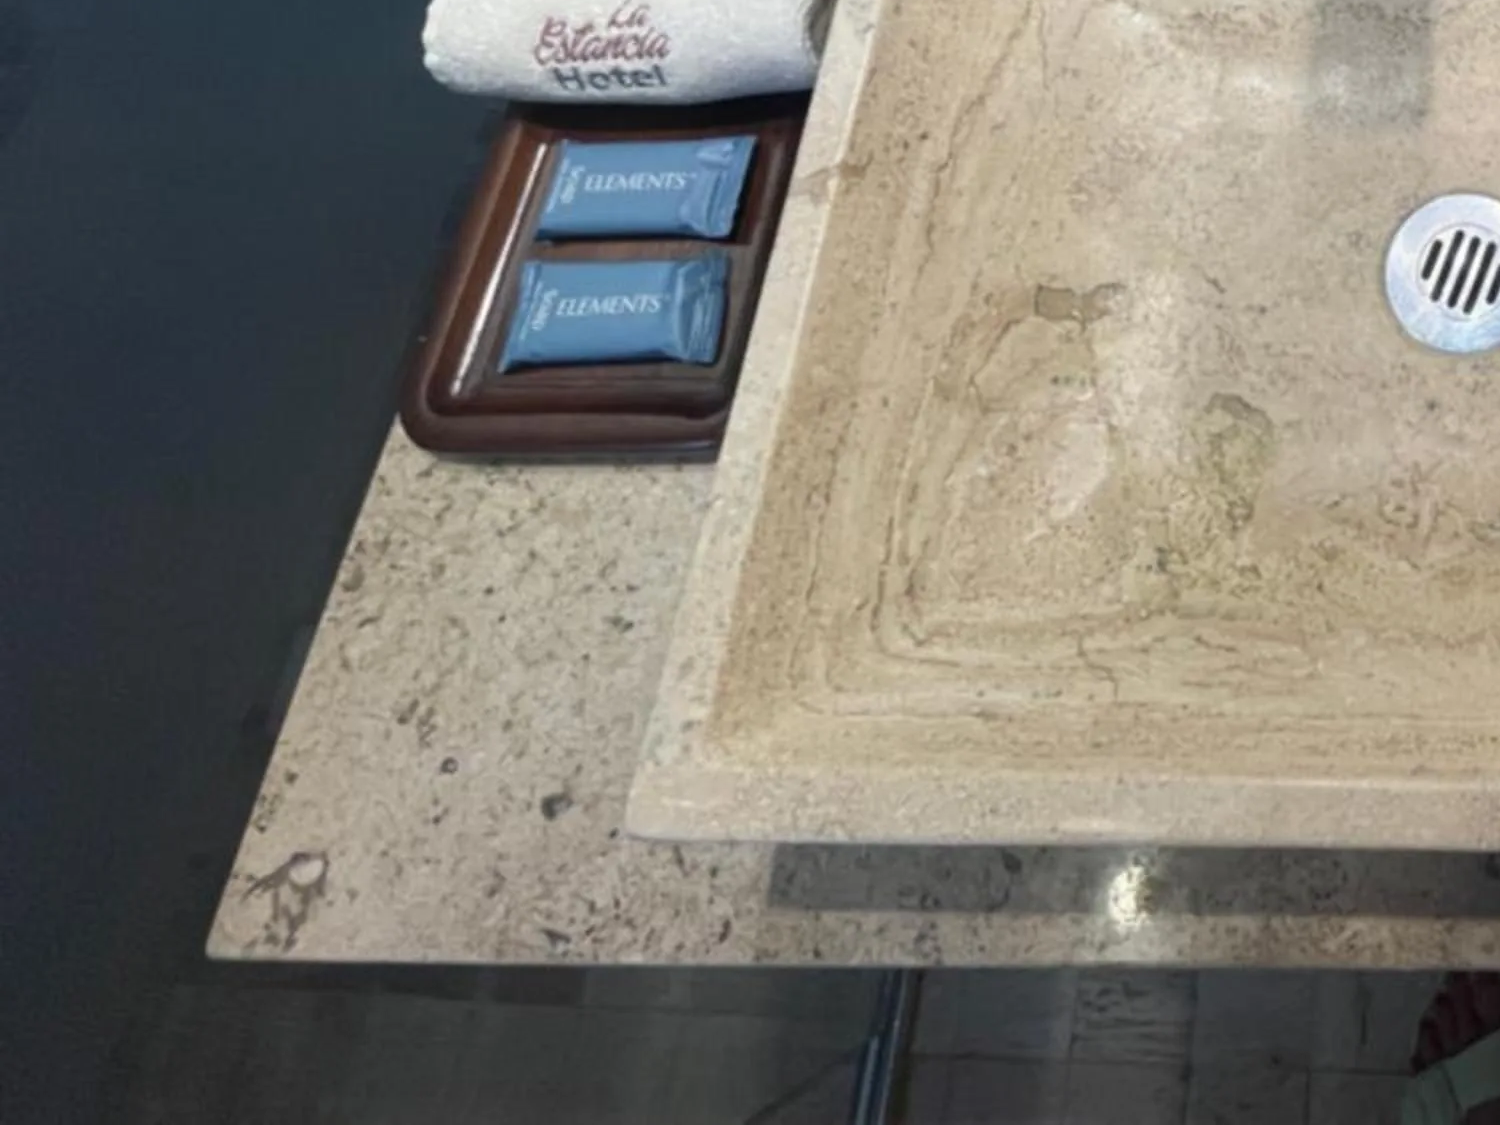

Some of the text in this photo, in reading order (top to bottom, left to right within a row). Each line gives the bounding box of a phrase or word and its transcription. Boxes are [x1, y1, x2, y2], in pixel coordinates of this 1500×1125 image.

[534, 16, 671, 66] Estancia
[551, 63, 668, 92] Hotel
[583, 172, 688, 192] ELEMENTS
[556, 293, 663, 317] ELEMENTS
